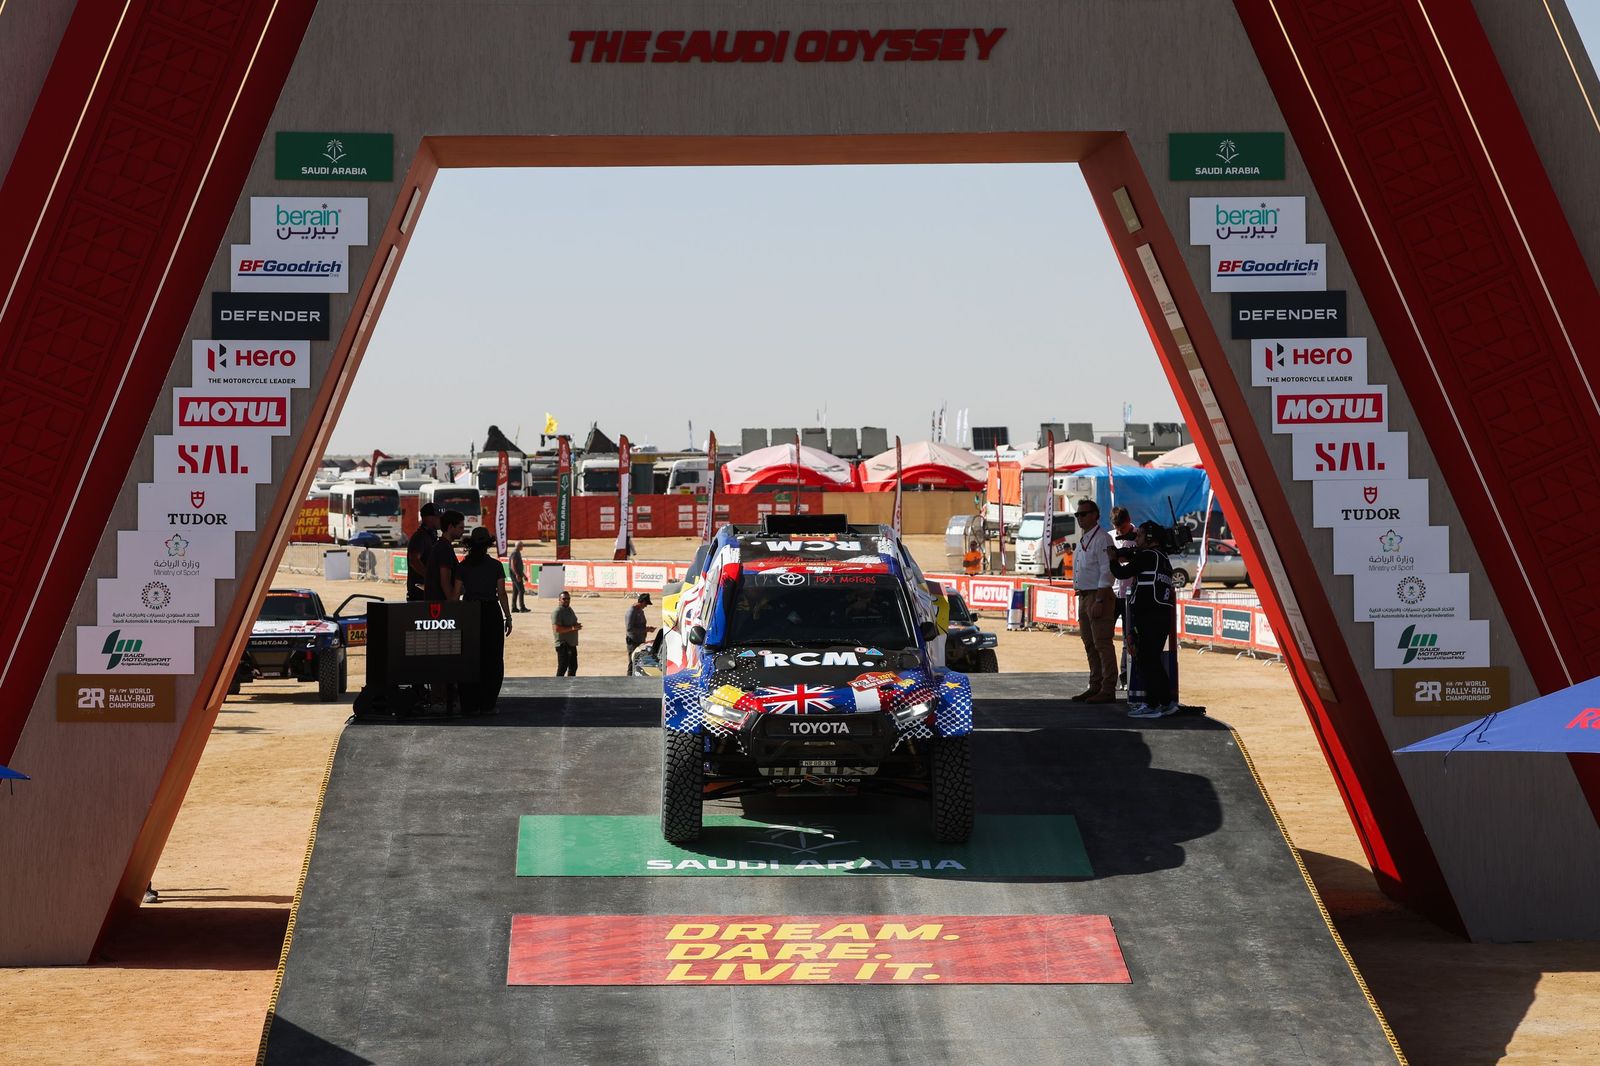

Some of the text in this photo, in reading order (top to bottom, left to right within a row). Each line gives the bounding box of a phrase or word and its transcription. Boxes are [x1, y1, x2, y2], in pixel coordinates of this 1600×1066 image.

[568, 28, 1007, 63] THE SAUDI ODYSSEY
[301, 166, 368, 175] SAUDI ARABIA
[1195, 166, 1260, 175] SAUDI ARABIA
[276, 203, 339, 226] berain
[1216, 203, 1278, 226] berain
[276, 227, 339, 240] بيرين
[1216, 226, 1278, 240] بيرين
[239, 259, 342, 273] BFGoodrich
[1217, 259, 1319, 273] BFGoodrich
[220, 309, 321, 322] DEFENDER
[1239, 308, 1338, 321] DEFENDER
[235, 349, 296, 367] Hero
[1293, 347, 1353, 365] Hero
[183, 401, 282, 422] MOTUL
[1282, 398, 1378, 420] MOTUL
[167, 513, 228, 525] TUDOR
[299, 508, 328, 517] REAM
[1341, 508, 1401, 521] TUDOR
[296, 517, 323, 526] ARE.
[153, 559, 200, 569] وزارة الرياضة
[1368, 555, 1414, 565] وزارة الرياضة
[153, 569, 175, 577] Ministry
[183, 569, 200, 577] Sport
[1397, 564, 1414, 572] Sport
[974, 586, 1008, 601] MOTUL
[414, 619, 456, 630] TUDOR
[1185, 614, 1213, 627] DEFENDER
[1223, 618, 1249, 632] DEFENDER
[1445, 687, 1490, 695] RALLY-RAID
[109, 694, 154, 702] RALLY-RAID
[1445, 694, 1491, 702] CHAMPIONSHIP
[789, 722, 850, 734] TOYOTA
[646, 859, 967, 871] SAUDI ARABIA
[664, 923, 961, 941] DREAM.
[666, 942, 893, 961] DARE.
[665, 962, 942, 981] LIVE IT.
